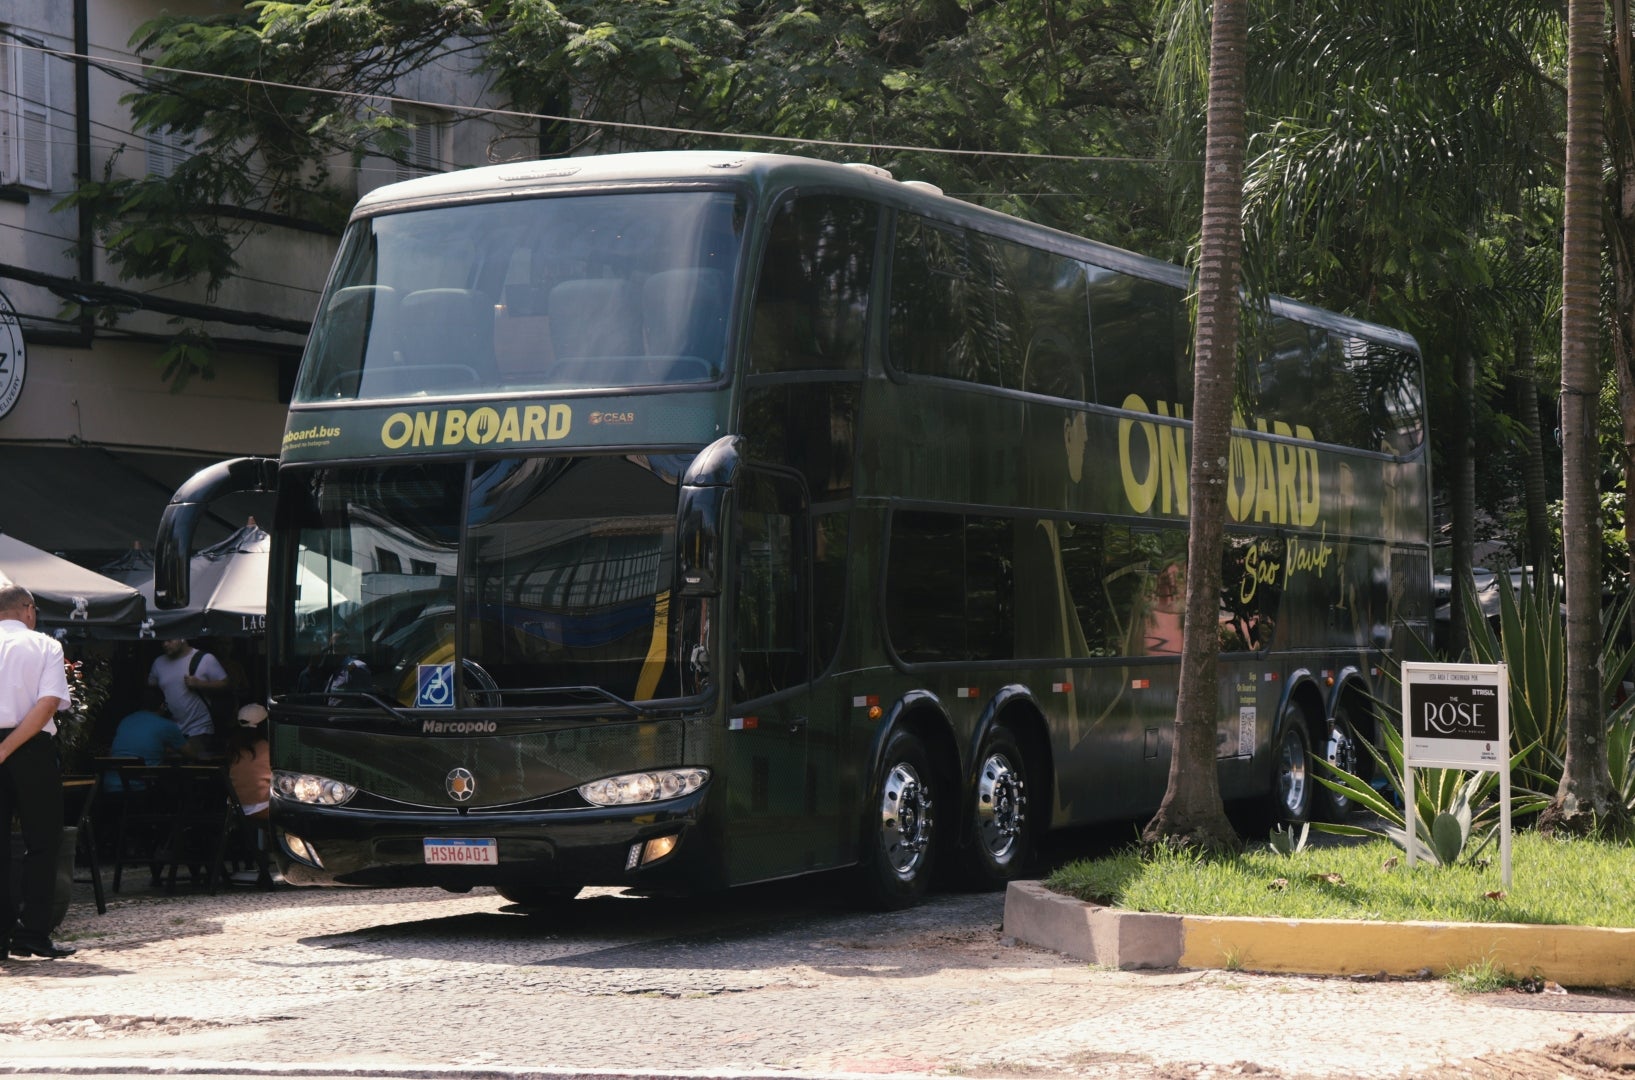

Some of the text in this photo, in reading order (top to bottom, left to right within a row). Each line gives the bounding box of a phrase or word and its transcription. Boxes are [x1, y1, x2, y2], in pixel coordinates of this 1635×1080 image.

[381, 403, 572, 449] ON BOARD
[1118, 393, 1321, 527] ON OARD
[422, 720, 497, 734] Marcopolo
[1424, 702, 1486, 733] ROSE
